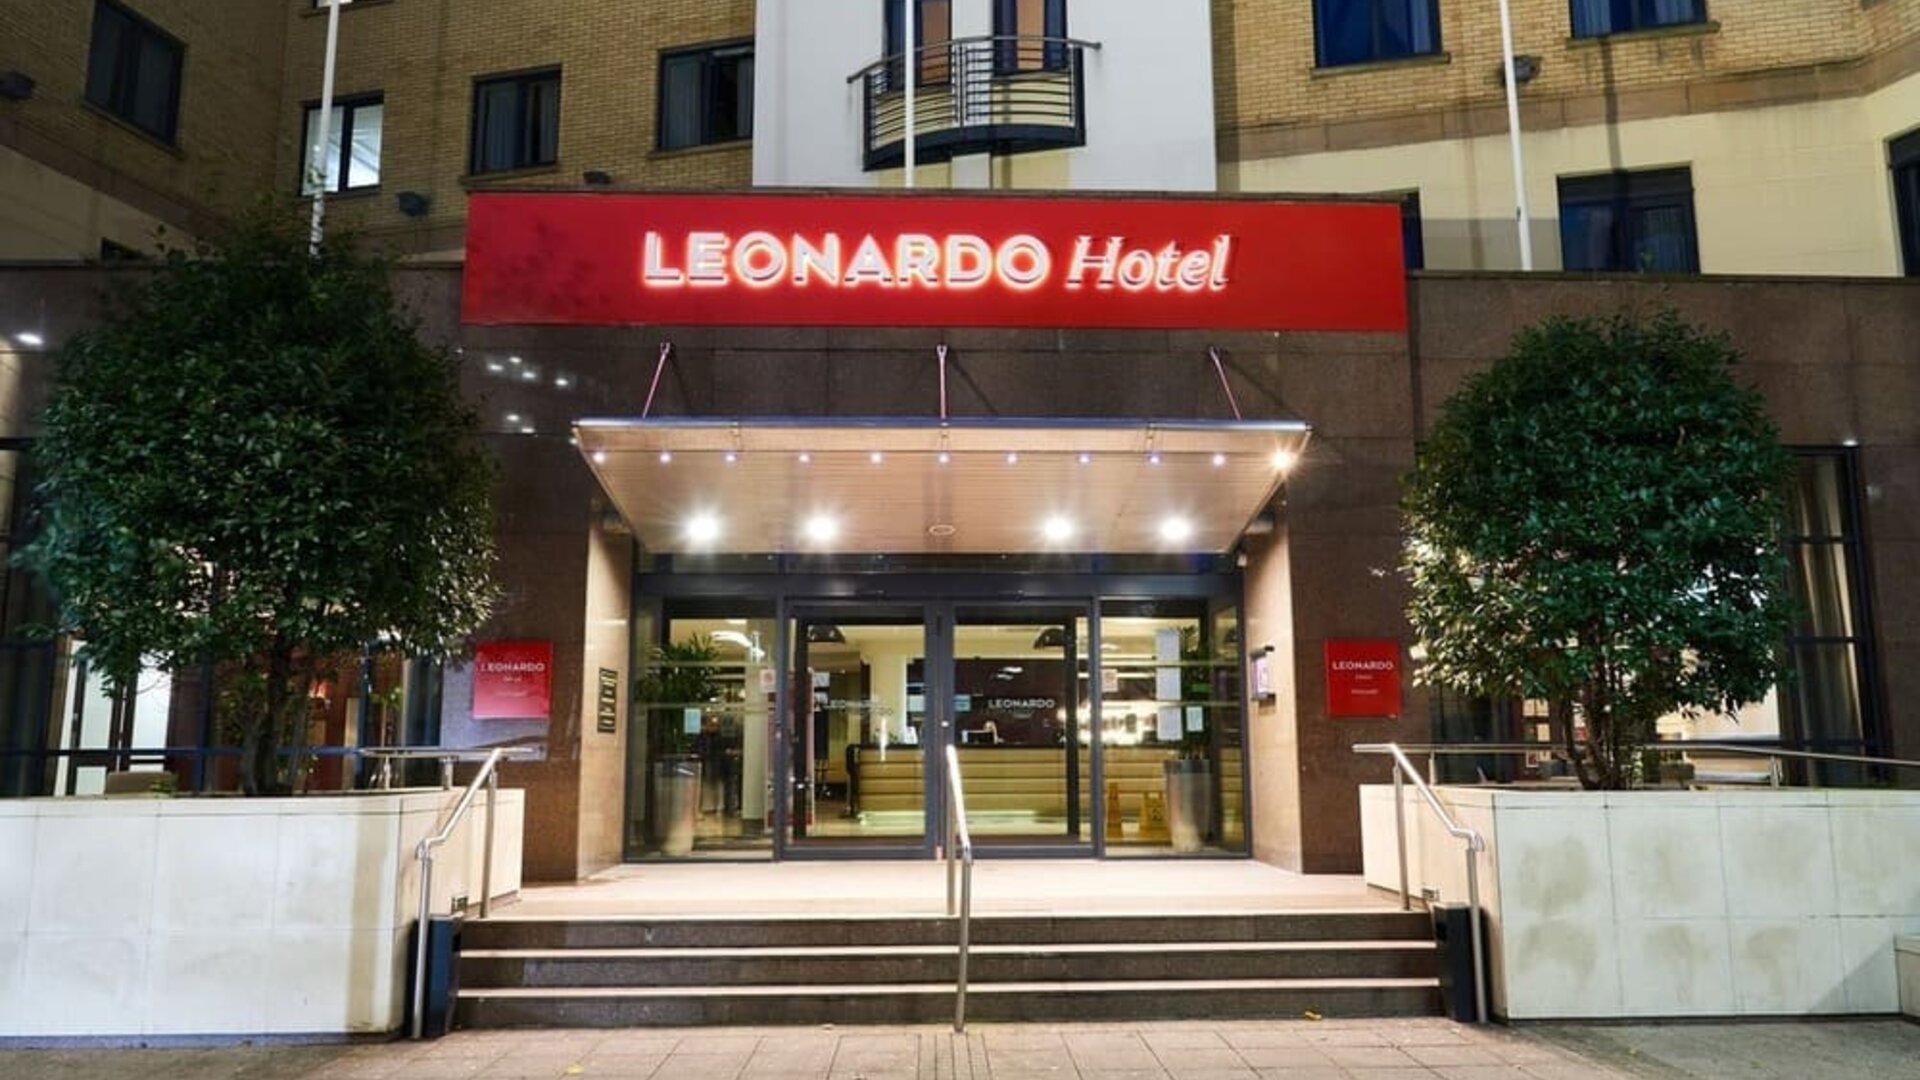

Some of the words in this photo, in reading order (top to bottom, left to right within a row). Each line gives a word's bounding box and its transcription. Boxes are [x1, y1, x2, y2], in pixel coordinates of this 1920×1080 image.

[643, 230, 1051, 288] LEONARDO
[1065, 234, 1231, 292] Hotel
[480, 662, 545, 673] LEONARDO
[1332, 660, 1394, 671] LEONARDO
[987, 698, 1055, 709] LEONARDO
